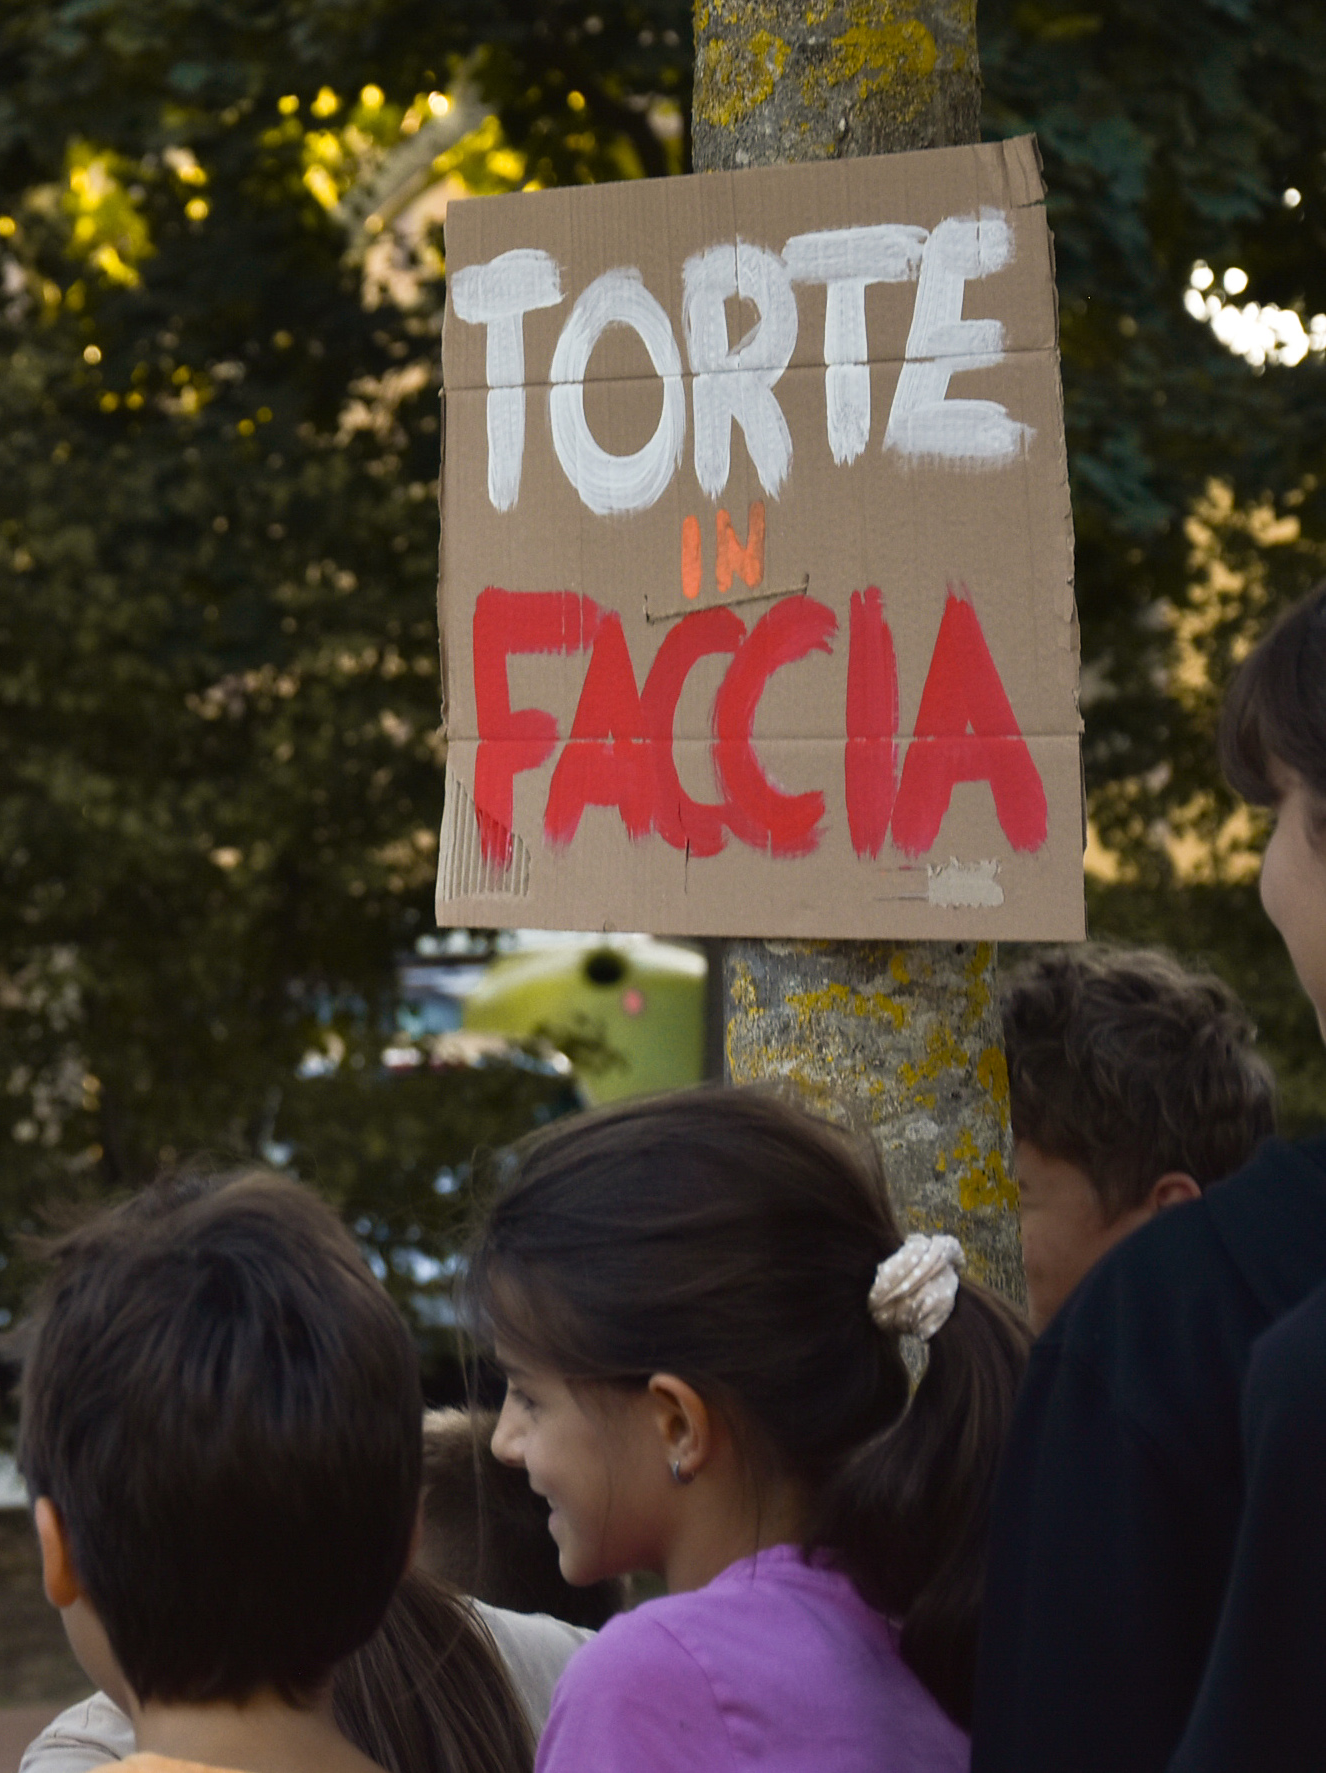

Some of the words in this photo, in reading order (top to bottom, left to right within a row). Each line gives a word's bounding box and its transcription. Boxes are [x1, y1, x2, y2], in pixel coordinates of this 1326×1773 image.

[450, 209, 1035, 516] TORTE
[681, 502, 765, 599] IN
[473, 583, 1048, 868] FACCIA
